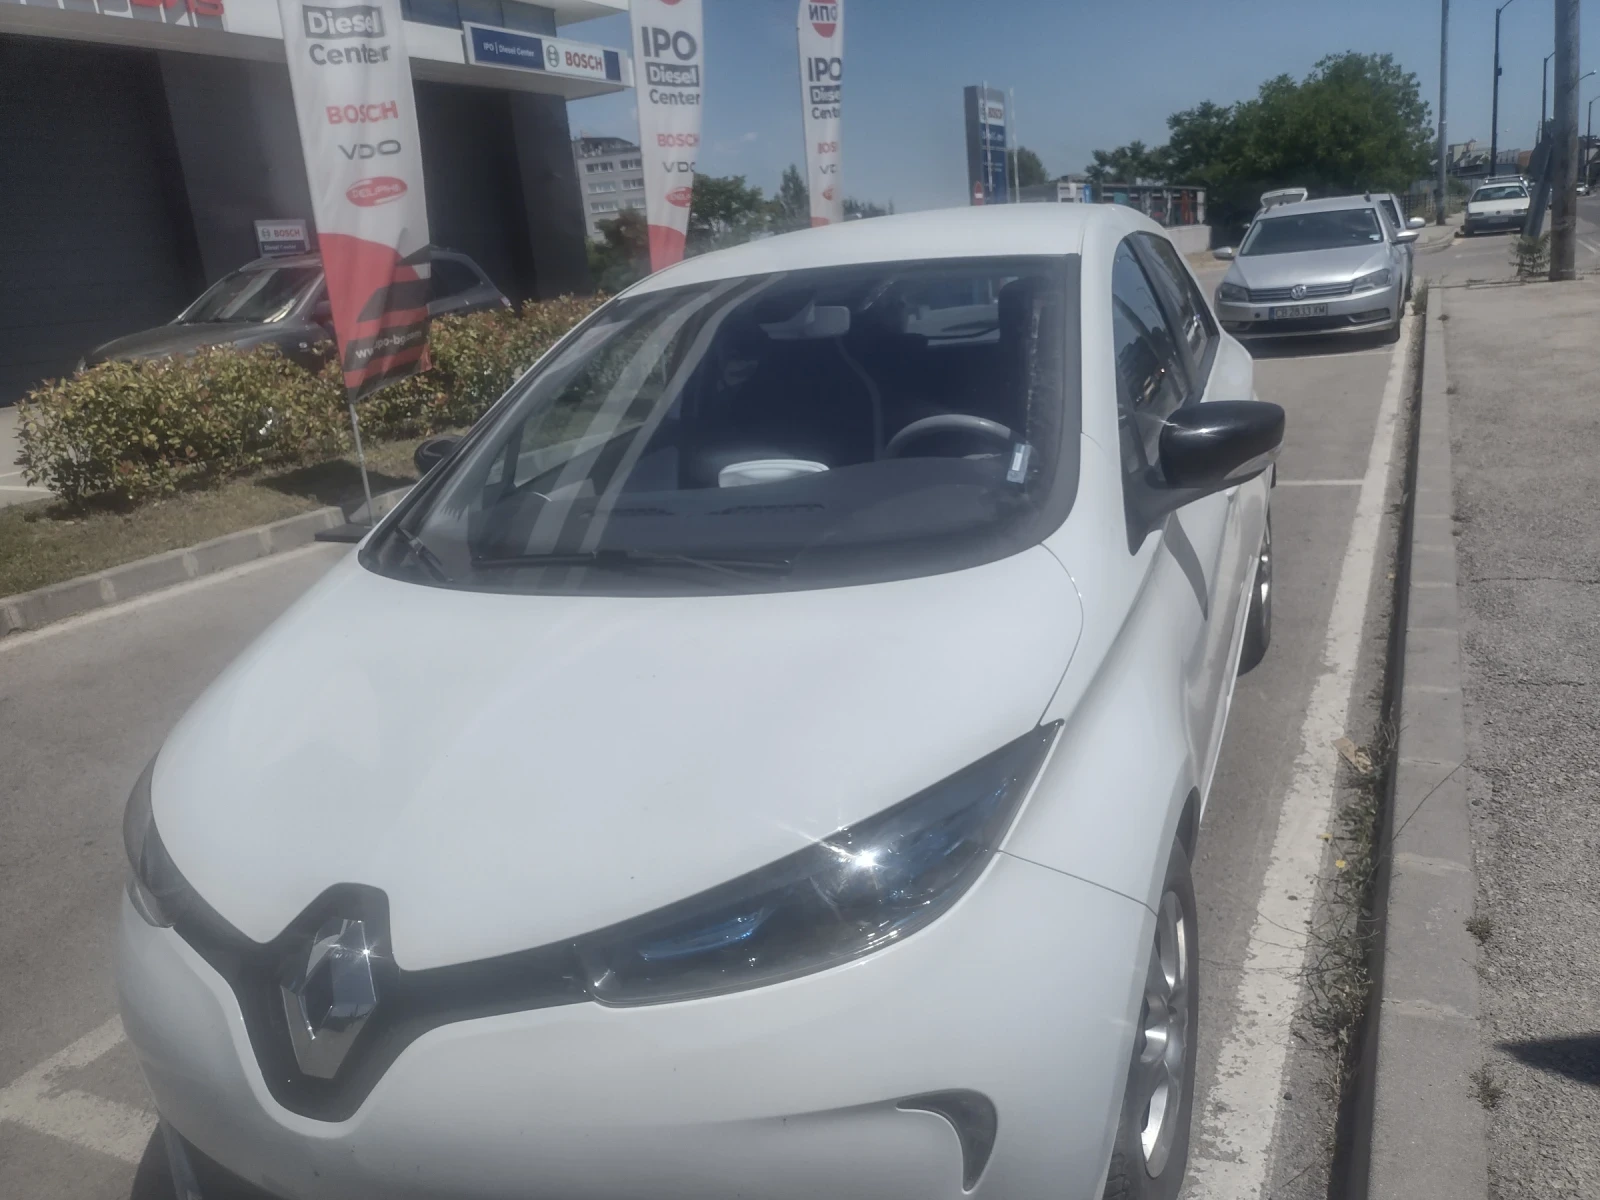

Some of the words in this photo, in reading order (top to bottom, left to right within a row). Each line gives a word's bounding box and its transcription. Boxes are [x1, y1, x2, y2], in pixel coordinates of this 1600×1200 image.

[307, 10, 380, 34] Diesel
[308, 43, 391, 65] Center
[641, 26, 697, 61] IPO
[565, 51, 603, 71] BOSCH
[808, 57, 842, 82] IPO
[649, 65, 697, 84] Diesel
[649, 88, 700, 105] Center
[326, 100, 398, 125] BOSCH
[338, 139, 402, 160] VDO
[274, 228, 300, 237] BOSCH
